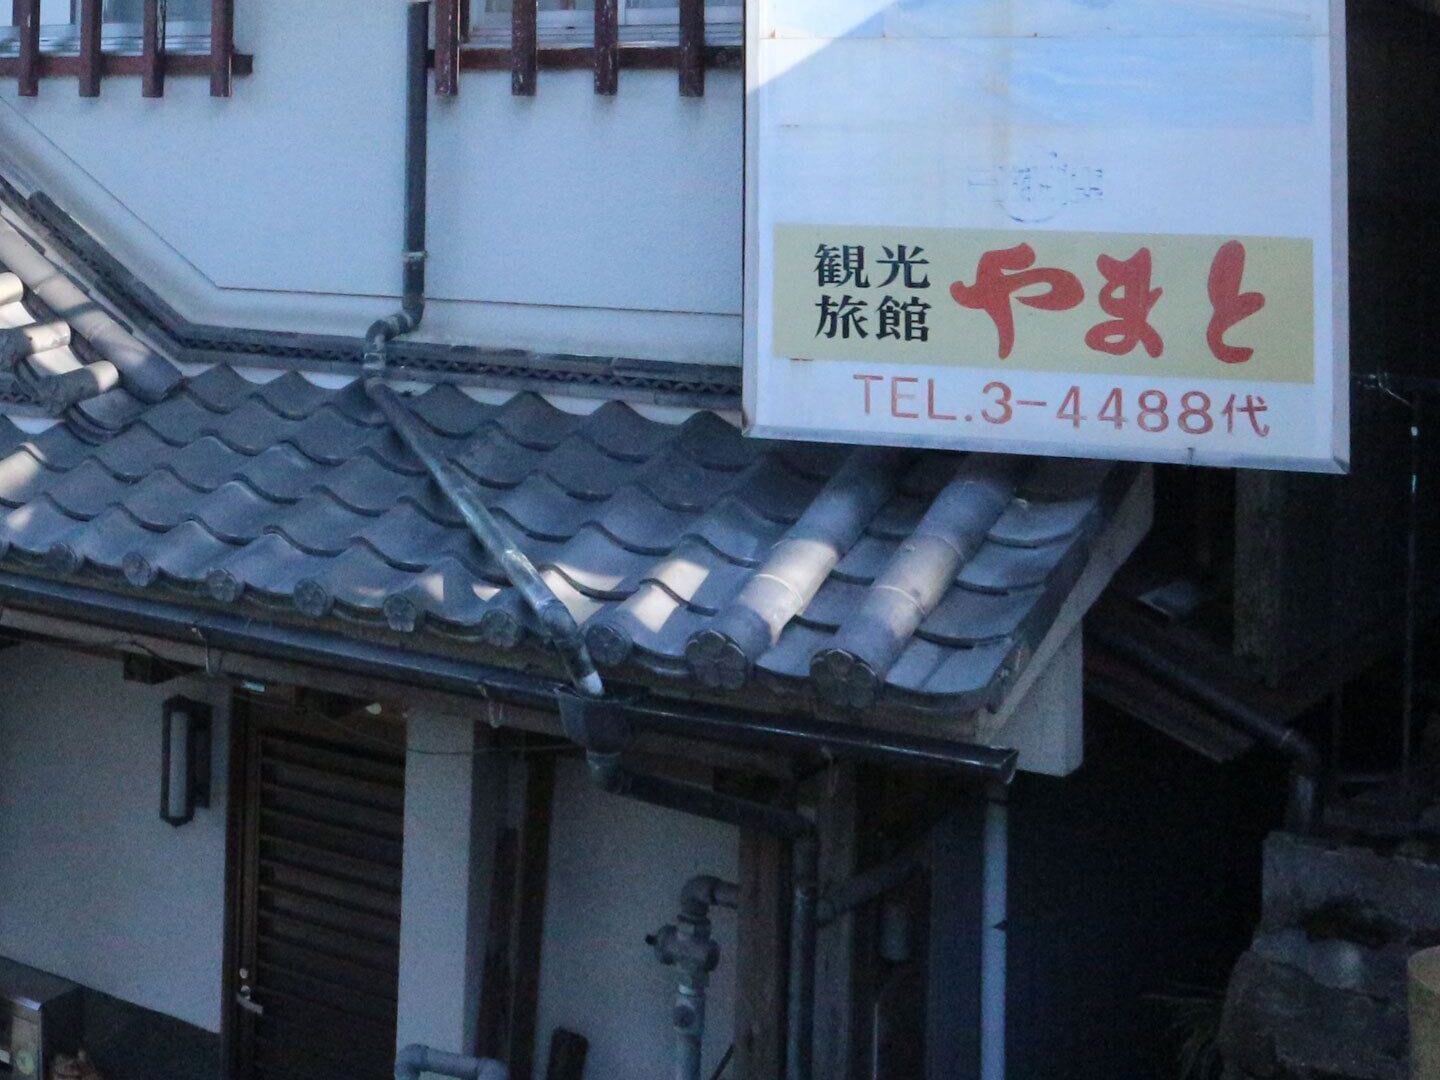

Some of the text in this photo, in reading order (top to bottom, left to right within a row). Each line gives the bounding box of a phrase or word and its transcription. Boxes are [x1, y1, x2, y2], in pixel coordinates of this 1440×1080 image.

[814, 243, 931, 289] 観光
[814, 295, 932, 343] 旅館
[949, 239, 1266, 365] やまと
